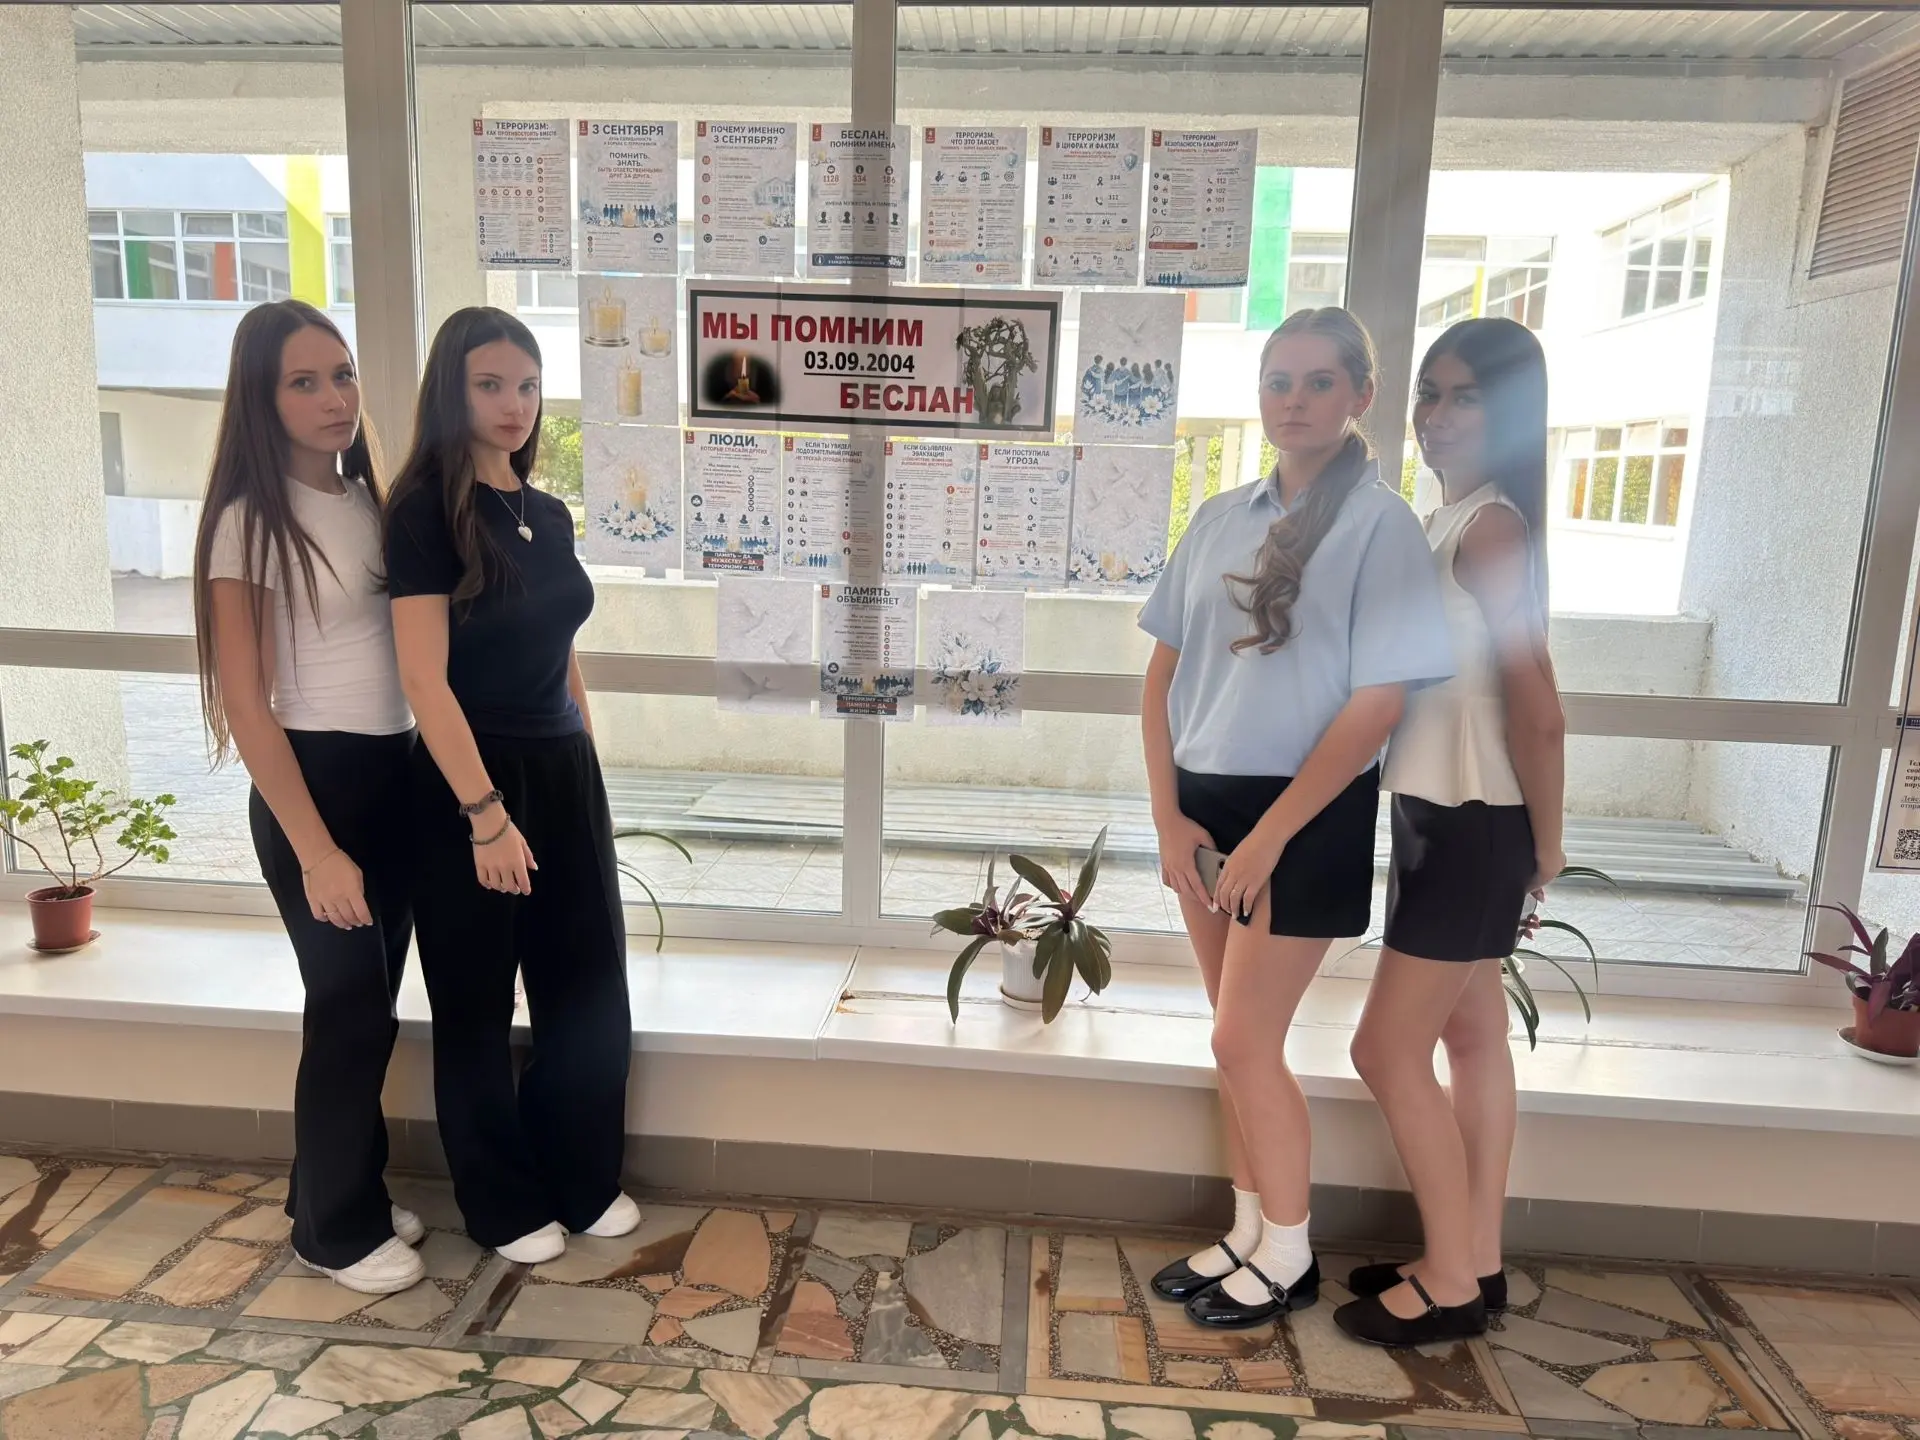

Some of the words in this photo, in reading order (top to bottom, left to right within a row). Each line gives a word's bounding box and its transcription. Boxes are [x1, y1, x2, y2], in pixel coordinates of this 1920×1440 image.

[496, 122, 549, 130] ТЕРРОРИЗМ:
[592, 124, 599, 135] 3
[602, 124, 664, 136] СЕНТЯБРЯ
[710, 125, 746, 134] ПОЧЕМУ
[748, 126, 785, 135] ИМЕННО
[713, 135, 719, 143] 3
[722, 135, 778, 145] СЕНТЯБРЯ?
[841, 130, 889, 140] БЕСЛАН.
[1068, 133, 1116, 141] ТЕРРОРИЗМ
[867, 141, 896, 149] ИМЕНА
[702, 311, 758, 341] МЫ
[770, 313, 924, 347] ПОМНИМ
[804, 350, 915, 374] 03.09.2004
[839, 382, 974, 415] БЕСЛАН
[708, 433, 758, 448] ЛЮДИ,
[1012, 449, 1050, 457] ПОСТУПИЛА
[1006, 456, 1039, 465] УГРОЗА
[844, 586, 891, 596] ПАМЯТЬ
[836, 595, 900, 605] ОБЪЕДИНЯЕТ
